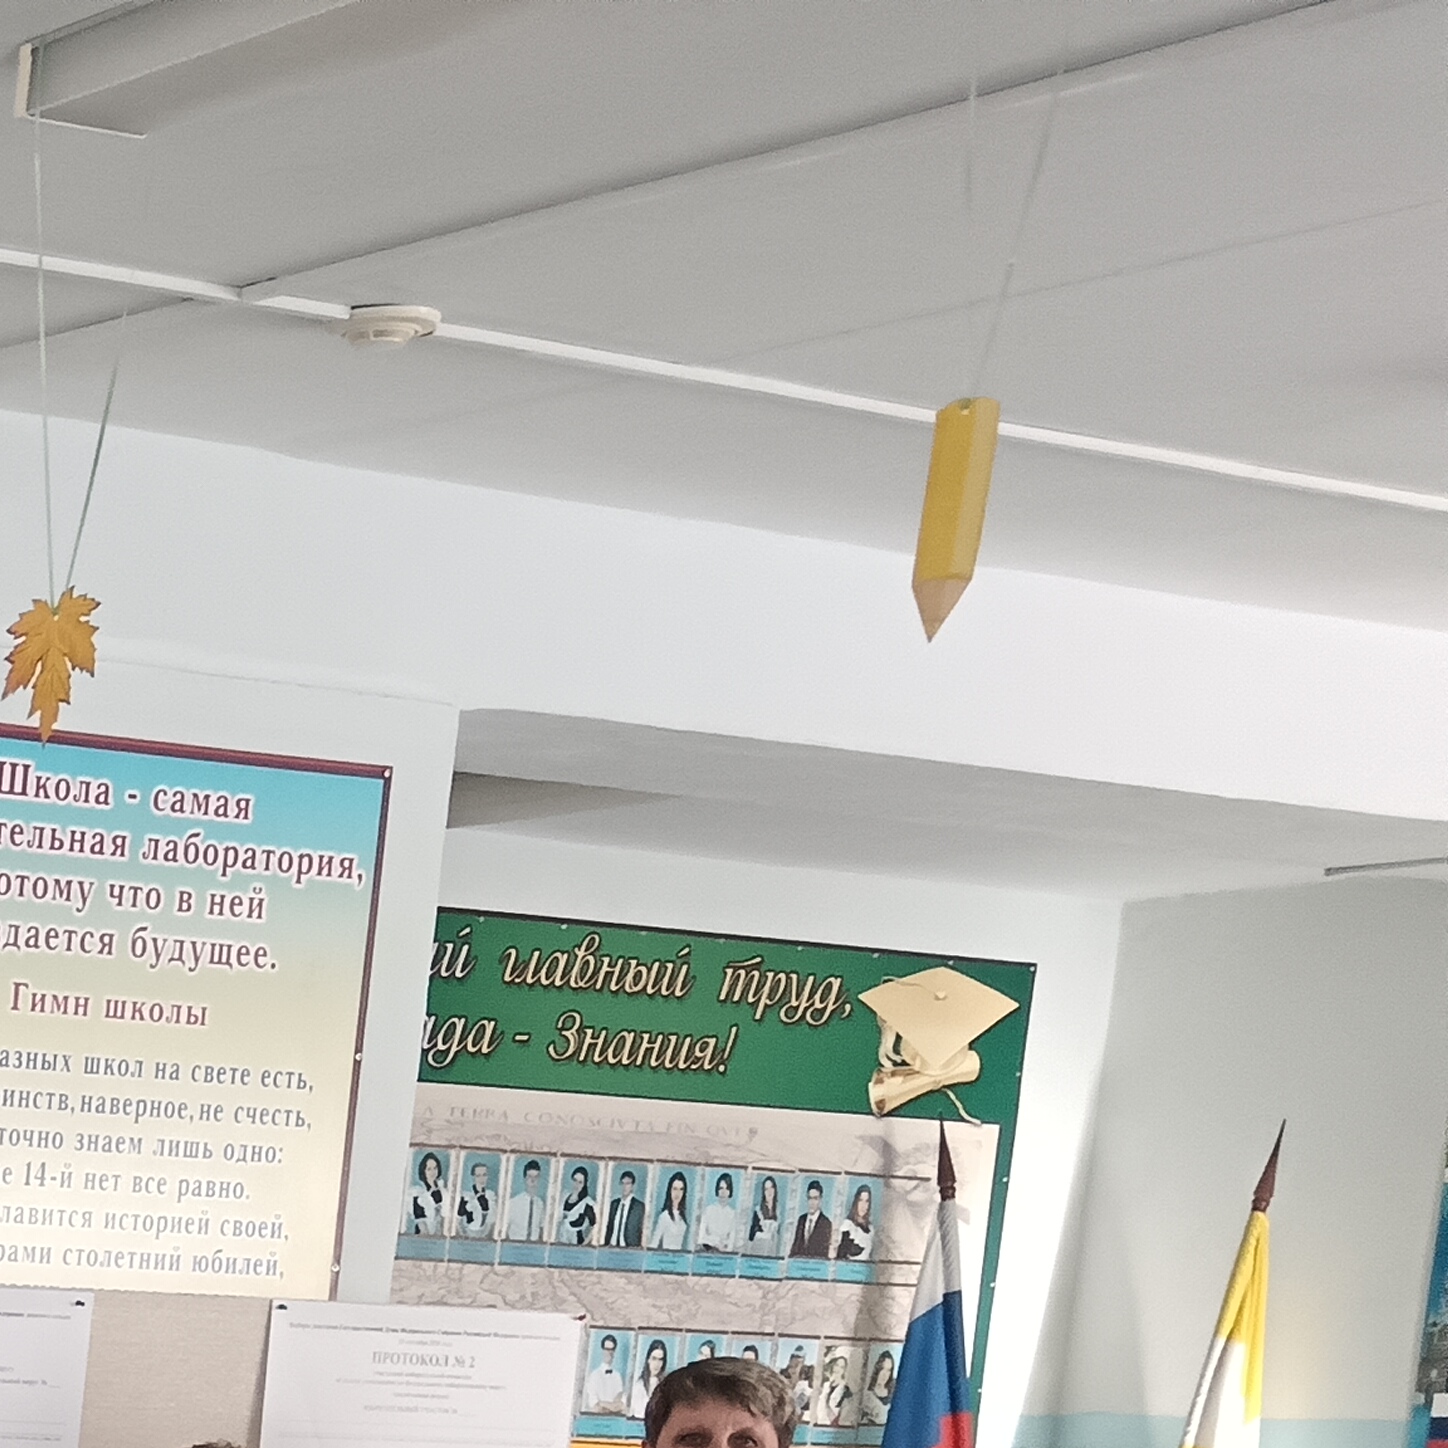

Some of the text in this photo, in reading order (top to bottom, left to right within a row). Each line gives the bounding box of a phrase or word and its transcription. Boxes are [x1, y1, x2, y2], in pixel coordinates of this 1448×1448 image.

[152, 784, 252, 822] самая
[142, 832, 364, 886] лаборатория,
[107, 883, 162, 912] что
[176, 889, 194, 914] в
[207, 887, 267, 922] ней
[129, 924, 278, 974] будущее.
[501, 934, 694, 1001] главный
[718, 956, 856, 1026] труд,
[10, 982, 210, 1028] Гимн школы
[546, 1013, 739, 1076] Знания!
[83, 1053, 144, 1080] школ
[154, 1061, 181, 1085] на
[190, 1061, 252, 1088] свете
[260, 1066, 315, 1096] есть,
[232, 1103, 313, 1134] счесть,
[73, 1131, 144, 1158] знаем
[151, 1136, 214, 1162] лишь
[222, 1143, 285, 1168] одно:
[22, 1160, 75, 1189] 14-й
[82, 1170, 124, 1194] нет
[131, 1172, 169, 1196] все
[176, 1176, 252, 1206] равно.
[103, 1210, 212, 1242] историей
[219, 1214, 291, 1243] своей,
[61, 1244, 183, 1275] столетний
[190, 1249, 287, 1281] юбилей,
[372, 1350, 450, 1369] ПРОТОКОЛ
[468, 1356, 476, 1369] 2
